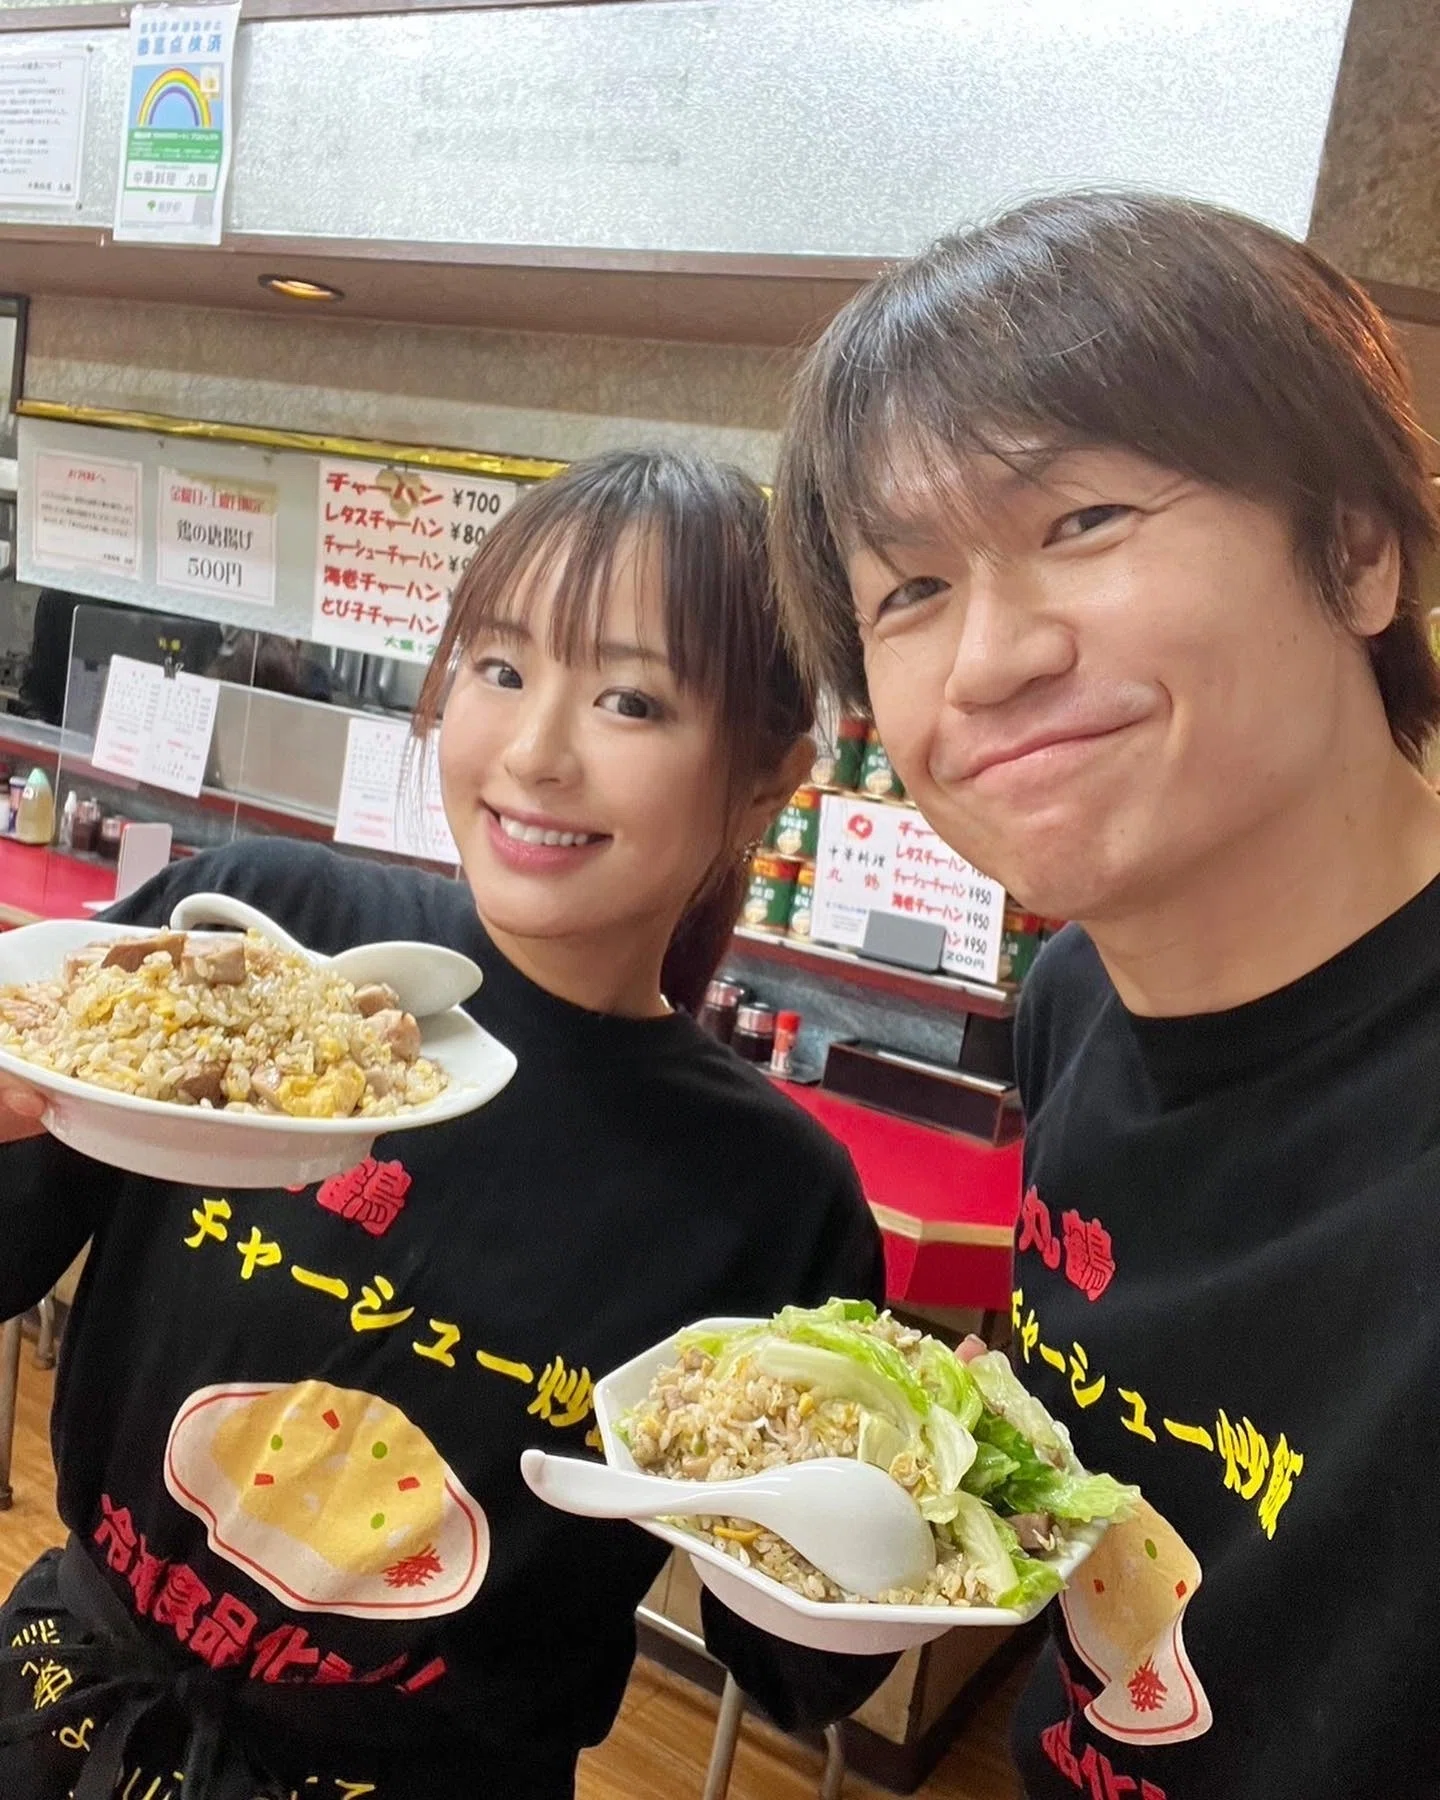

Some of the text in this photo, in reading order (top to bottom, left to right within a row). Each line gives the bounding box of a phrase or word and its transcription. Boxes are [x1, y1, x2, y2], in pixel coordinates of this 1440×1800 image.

[326, 472, 501, 514] チャーハン ¥700
[177, 519, 254, 551] 鶏の唐揚げ
[324, 503, 487, 545] レタスチャーハン ¥80
[323, 534, 444, 571] チャーシューチャーハン
[187, 557, 242, 587] 500円
[323, 565, 441, 602] 海老チャーハン
[321, 598, 440, 635] とび子チャーハン
[898, 821, 938, 838] チャー
[895, 844, 967, 873] レタスチャーハン
[966, 909, 990, 932] ¥950
[945, 950, 986, 970] 200円
[964, 935, 988, 955] ¥950
[282, 1154, 415, 1237] 鶴
[183, 1197, 603, 1452] チャーシュー炒
